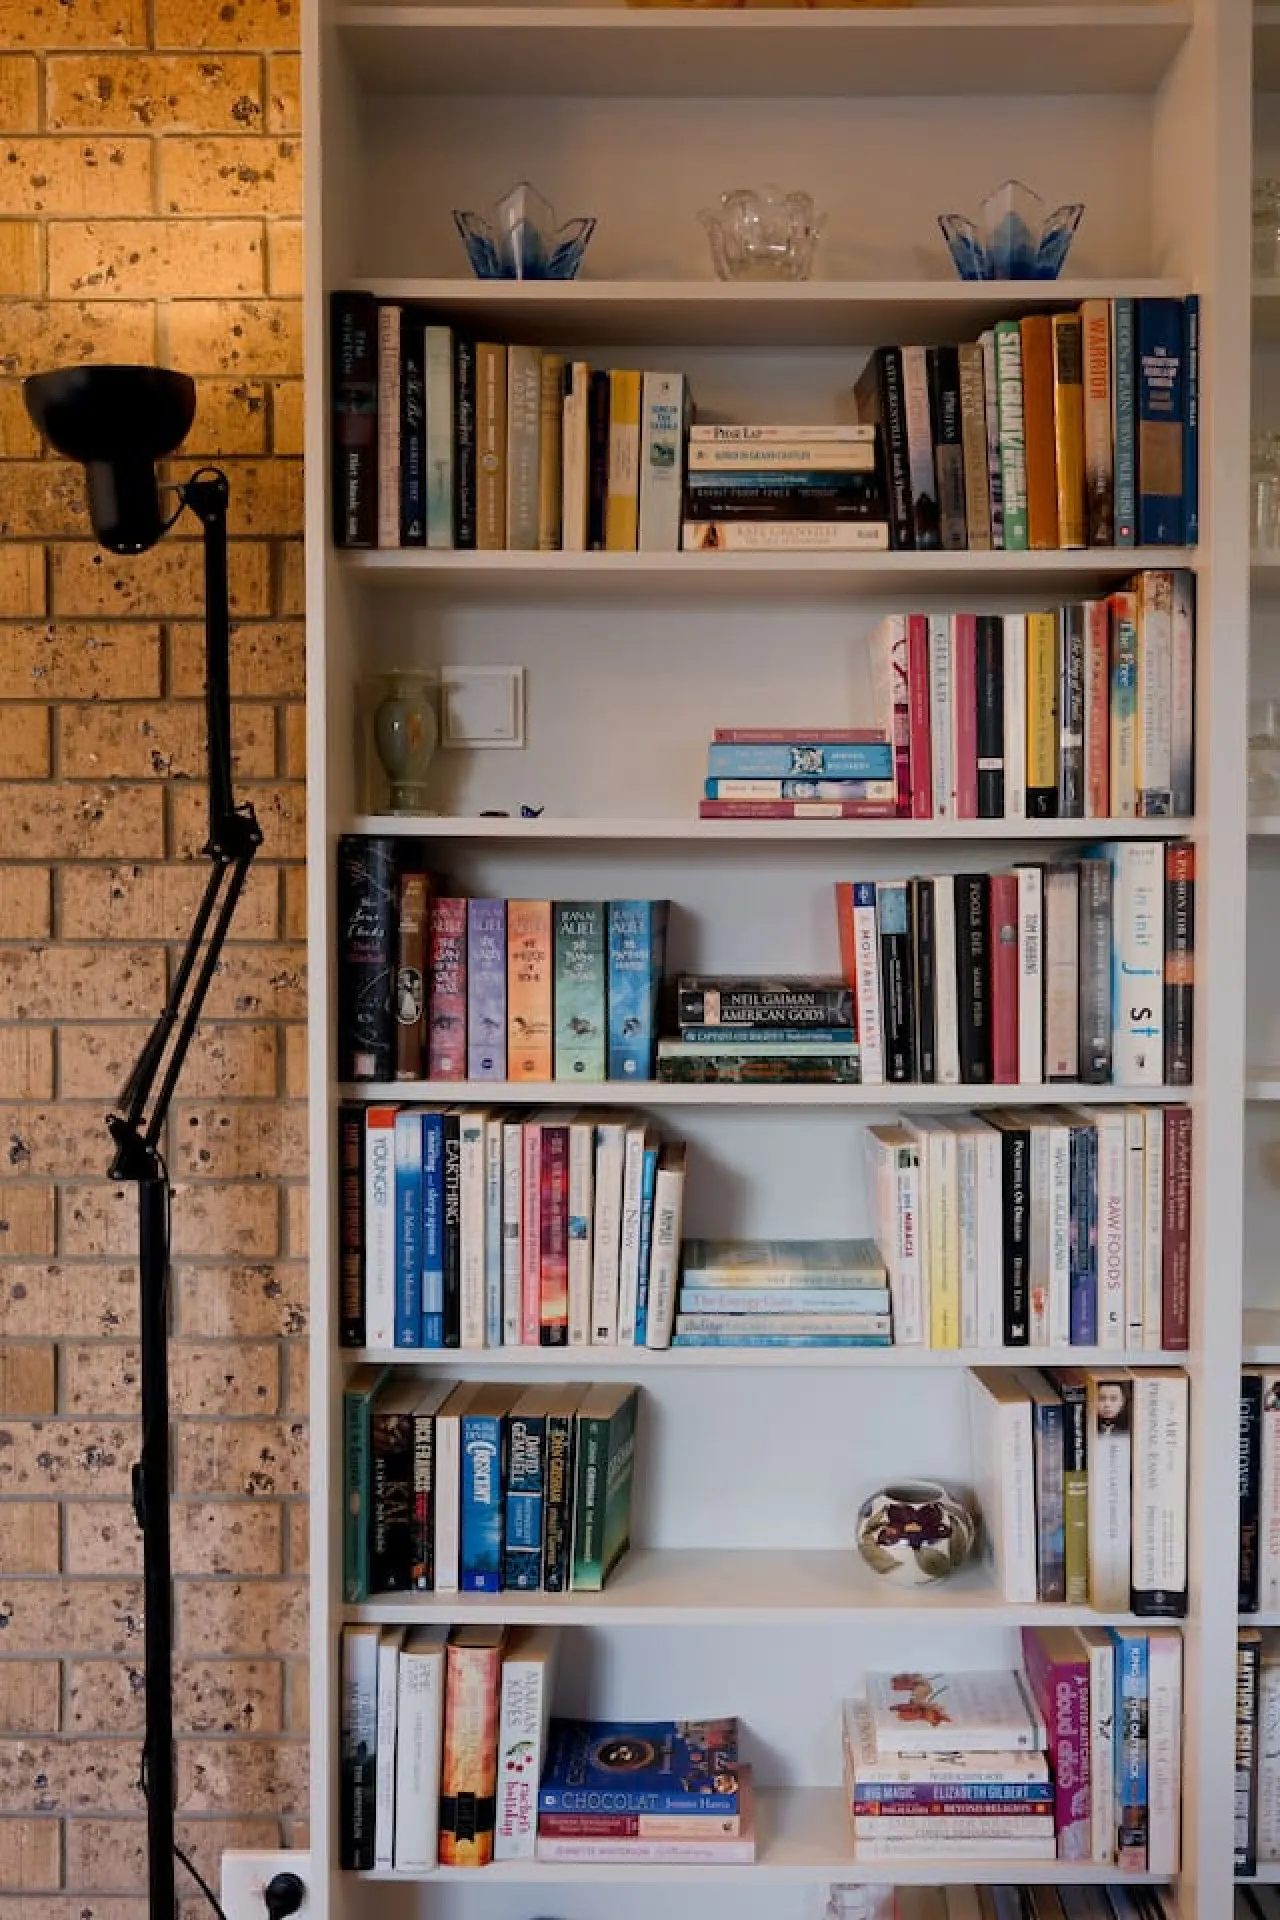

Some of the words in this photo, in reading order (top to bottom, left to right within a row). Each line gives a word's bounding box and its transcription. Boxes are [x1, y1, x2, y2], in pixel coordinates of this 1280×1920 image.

[1000, 331, 1021, 379] STAN
[1089, 318, 1107, 399] WARRIOR
[969, 882, 983, 926] FOOLS
[1024, 912, 1039, 933] TOM
[1024, 935, 1039, 976] ROBBINS
[721, 1008, 785, 1021] AMERICAN
[788, 1008, 825, 1021] GODS
[731, 993, 761, 1005] NEIL
[762, 993, 815, 1005] GAIMAN
[445, 1139, 459, 1225] EARTHING
[1107, 1197, 1121, 1229] RAW
[1107, 1233, 1121, 1290] FOODS
[510, 1422, 527, 1485] GEMMELL
[525, 1435, 540, 1475] DAVID
[508, 1679, 523, 1729] KEYES
[523, 1669, 539, 1735] MARIAN
[1079, 1687, 1089, 1723] DAVID
[1079, 1725, 1089, 1781] MITCHELL
[561, 1792, 659, 1810] CHOCOLAT
[883, 1786, 916, 1800] MAGIC
[987, 1785, 1029, 1800] GILBERT
